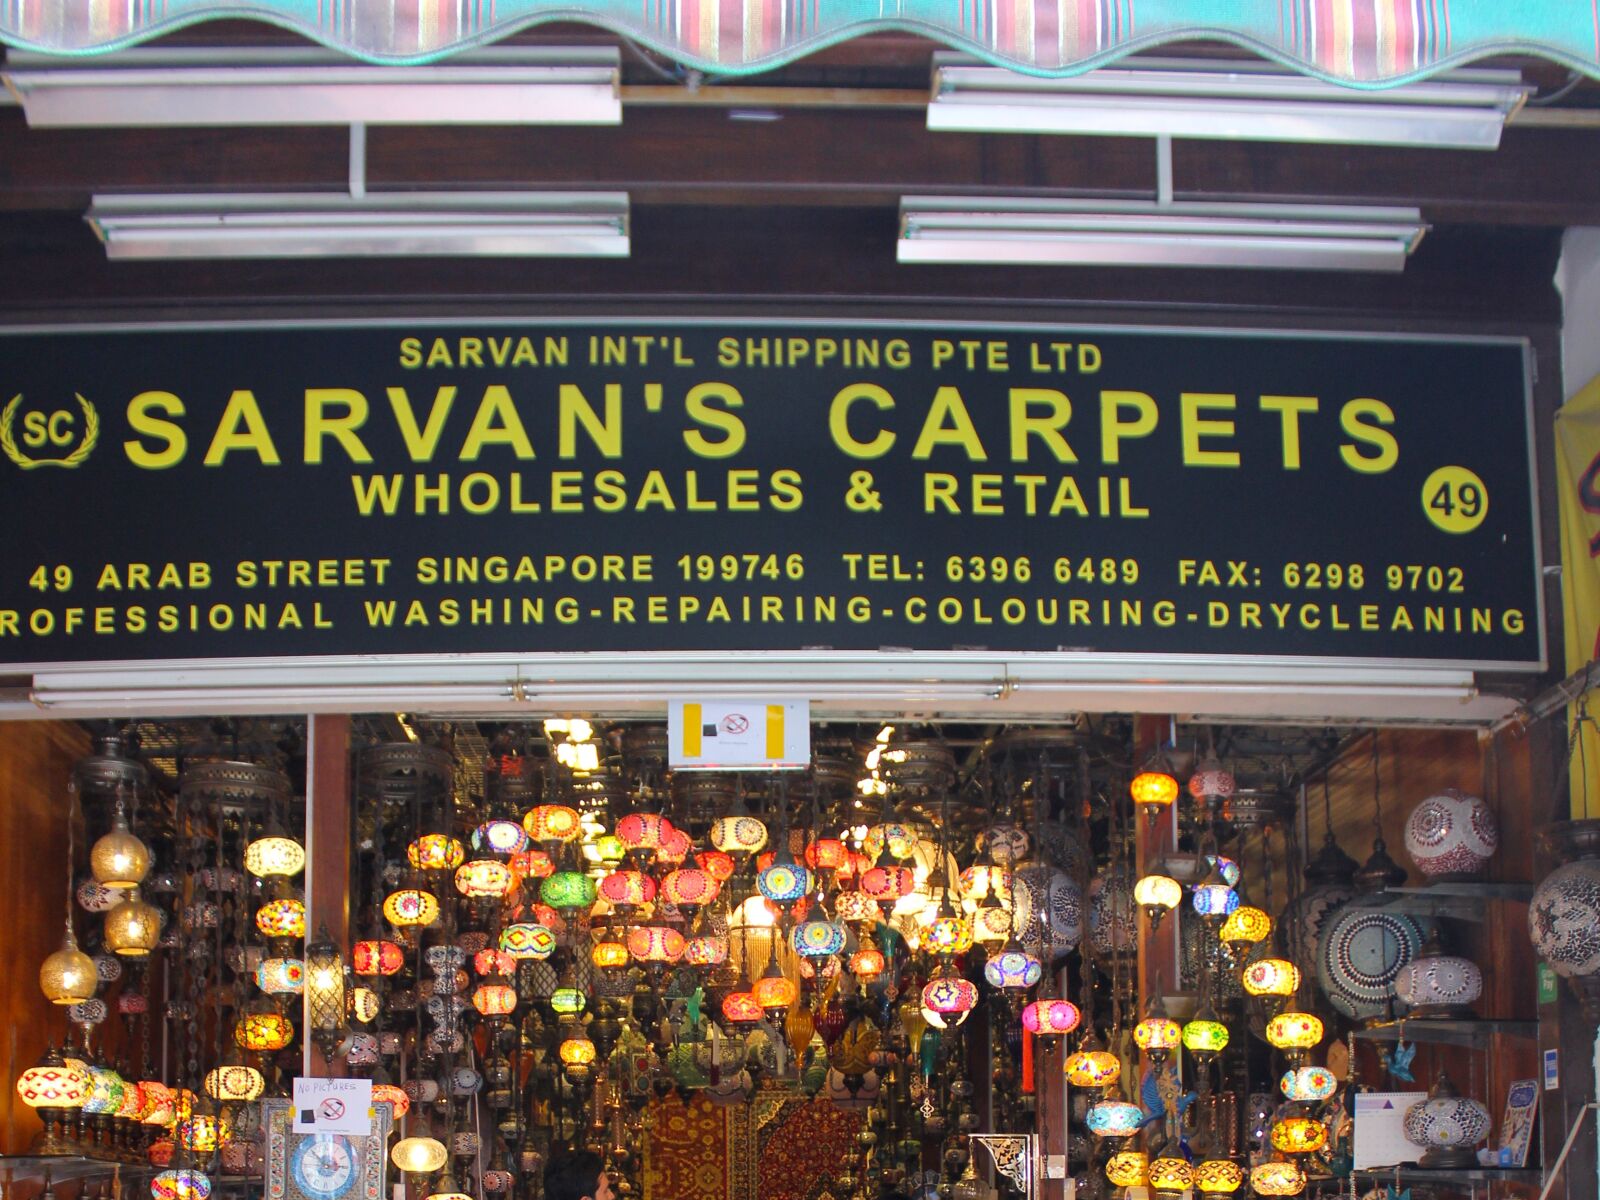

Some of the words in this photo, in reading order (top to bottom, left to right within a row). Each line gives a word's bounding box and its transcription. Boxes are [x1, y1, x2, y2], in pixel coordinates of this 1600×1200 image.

[400, 336, 568, 368] SARVAN
[589, 335, 694, 366] INT'L
[718, 338, 912, 369] SHIPPING
[932, 340, 1009, 371] PTE
[1031, 342, 1102, 373] LTD
[23, 410, 75, 447] SC
[123, 381, 747, 469] SARVAN'S
[828, 383, 1400, 474] CARPETS
[351, 469, 805, 516] WHOLESALES
[844, 470, 883, 512] &
[924, 472, 1151, 518] RETAIL
[1431, 481, 1482, 517] 49
[29, 564, 73, 592] 49
[97, 560, 213, 590] ARAB
[236, 558, 392, 588] STREET
[417, 554, 653, 584] SINGAPORE
[677, 553, 806, 583] 199746
[842, 553, 925, 582] TEL:
[945, 555, 1033, 584] 6396
[1053, 557, 1140, 585] 6489
[1178, 559, 1262, 588] FAX:
[1283, 562, 1366, 590] 6298
[1386, 564, 1464, 592] 9702
[364, 595, 1525, 635] WASHING-REPAIRING-COLOURING-DRYCLEANING
